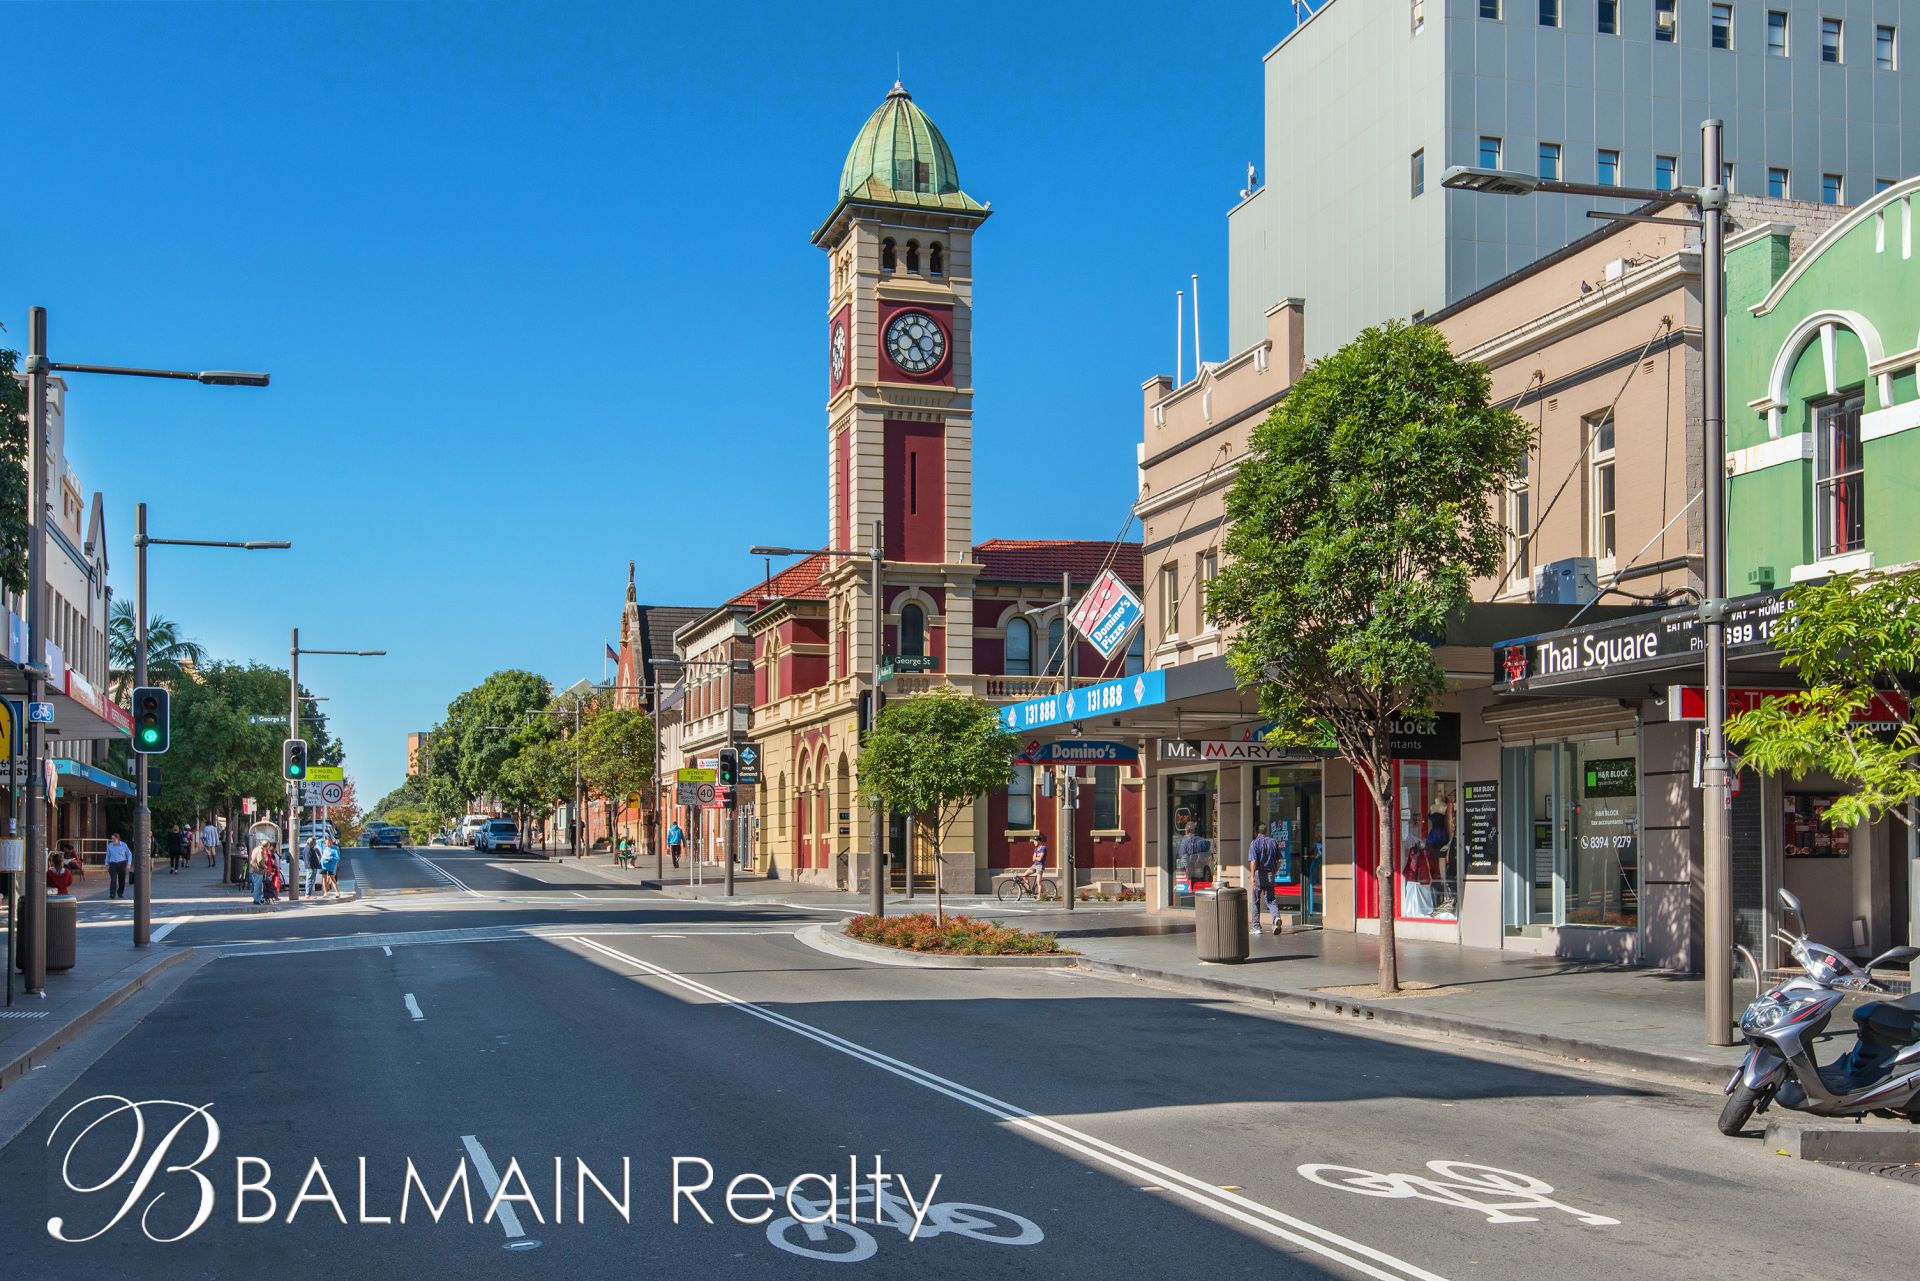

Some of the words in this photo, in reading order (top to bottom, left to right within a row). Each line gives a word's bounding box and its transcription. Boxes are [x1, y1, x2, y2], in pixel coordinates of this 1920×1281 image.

[1758, 603, 1785, 617] HOME
[1093, 599, 1131, 642] Domino's
[1100, 622, 1126, 650] Pizza
[1726, 624, 1753, 645] 699
[1537, 637, 1578, 675] Thai
[1583, 631, 1658, 670] Square
[894, 656, 921, 666] George
[923, 657, 931, 665] St
[1087, 688, 1101, 712] 131
[1103, 684, 1123, 708] 888
[1025, 703, 1038, 725] 131
[1040, 700, 1056, 722] 888
[1388, 720, 1438, 735] BLOCK
[1052, 743, 1117, 759] Domino's
[1168, 742, 1196, 757] Mr.
[1597, 770, 1610, 779] H&R
[1610, 769, 1628, 778] BLOCK
[325, 788, 340, 798] 40
[700, 789, 713, 798] 40
[1590, 836, 1609, 849] 8394
[1612, 835, 1632, 848] 9279
